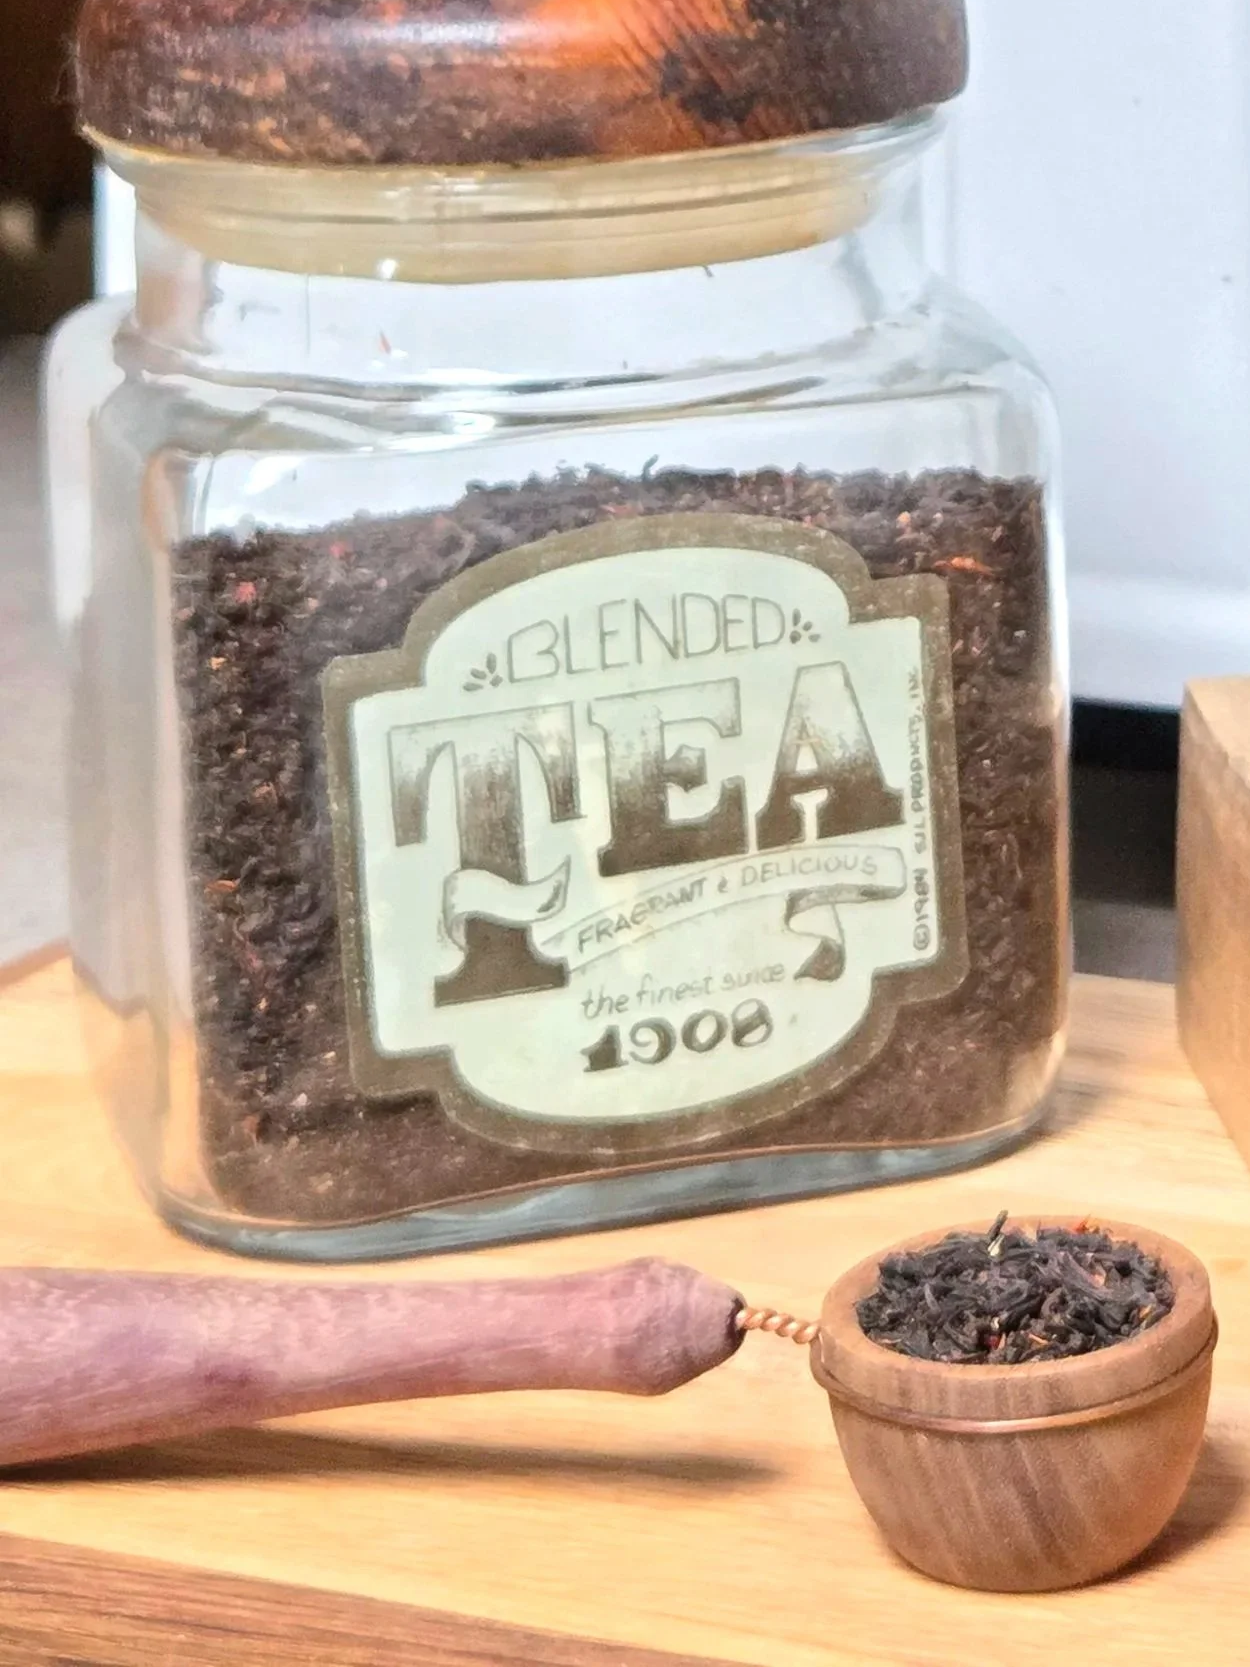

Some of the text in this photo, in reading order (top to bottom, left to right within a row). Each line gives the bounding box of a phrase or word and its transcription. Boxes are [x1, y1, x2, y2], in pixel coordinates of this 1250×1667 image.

[506, 592, 787, 683] BLENDED
[387, 659, 905, 1007] TEA
[576, 876, 708, 954] FRAGRANT
[740, 854, 879, 887] DELICIOUS
[580, 987, 629, 1020] the
[635, 972, 714, 1006] finest
[580, 997, 774, 1072] 1908
